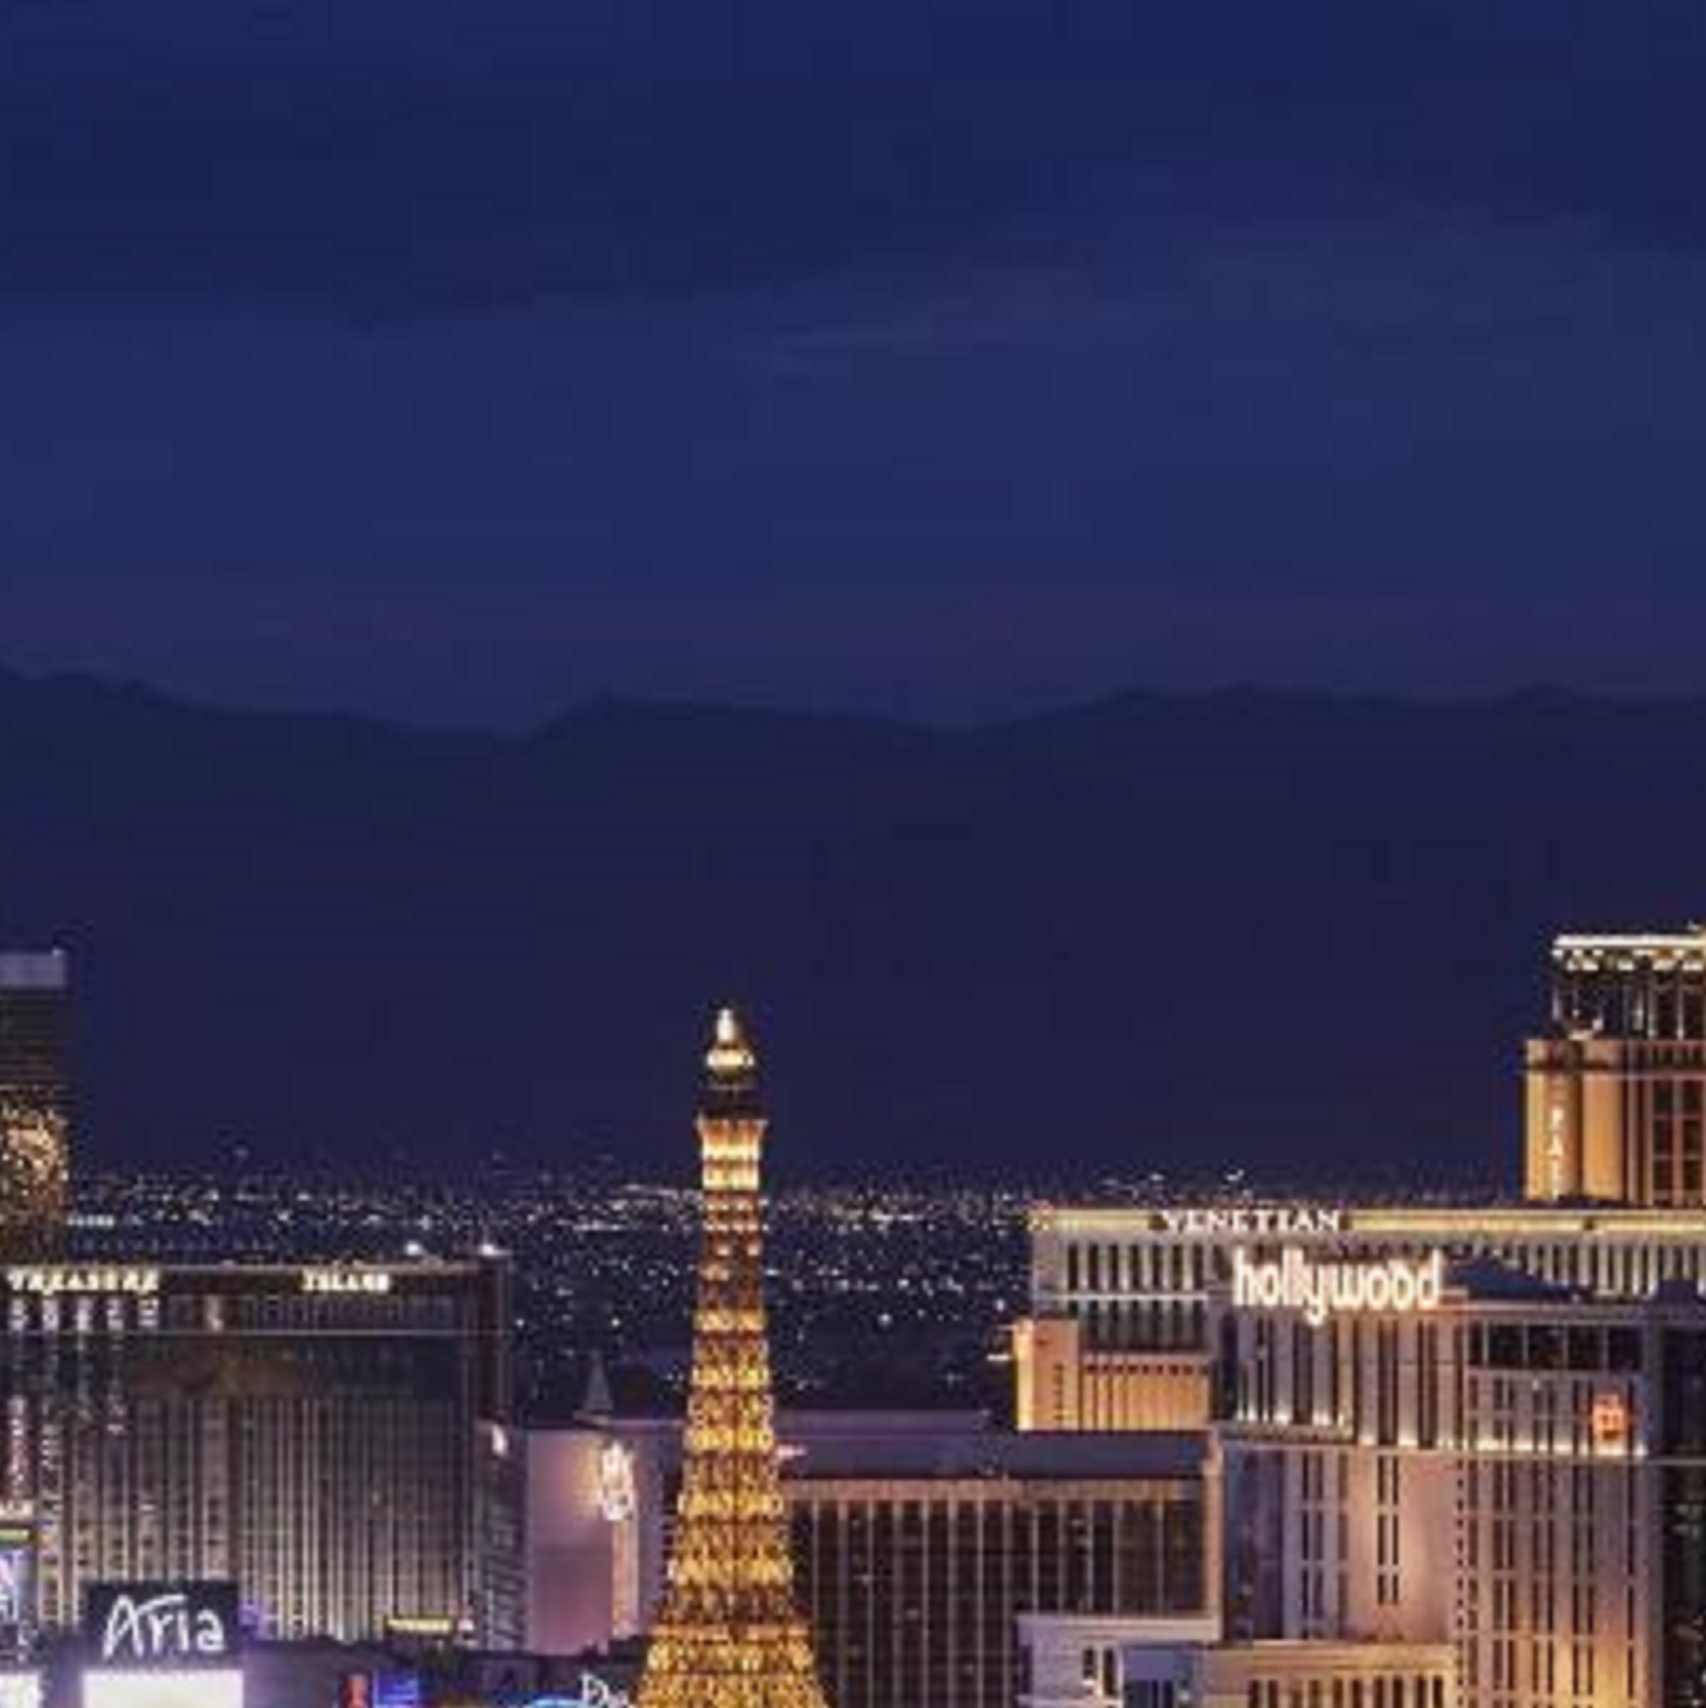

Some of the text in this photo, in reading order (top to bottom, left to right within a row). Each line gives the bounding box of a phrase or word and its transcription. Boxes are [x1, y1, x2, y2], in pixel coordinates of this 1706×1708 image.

[1161, 1208, 1341, 1233] VENETIAN
[1232, 1247, 1442, 1327] hollywood
[103, 1594, 225, 1660] Aria
